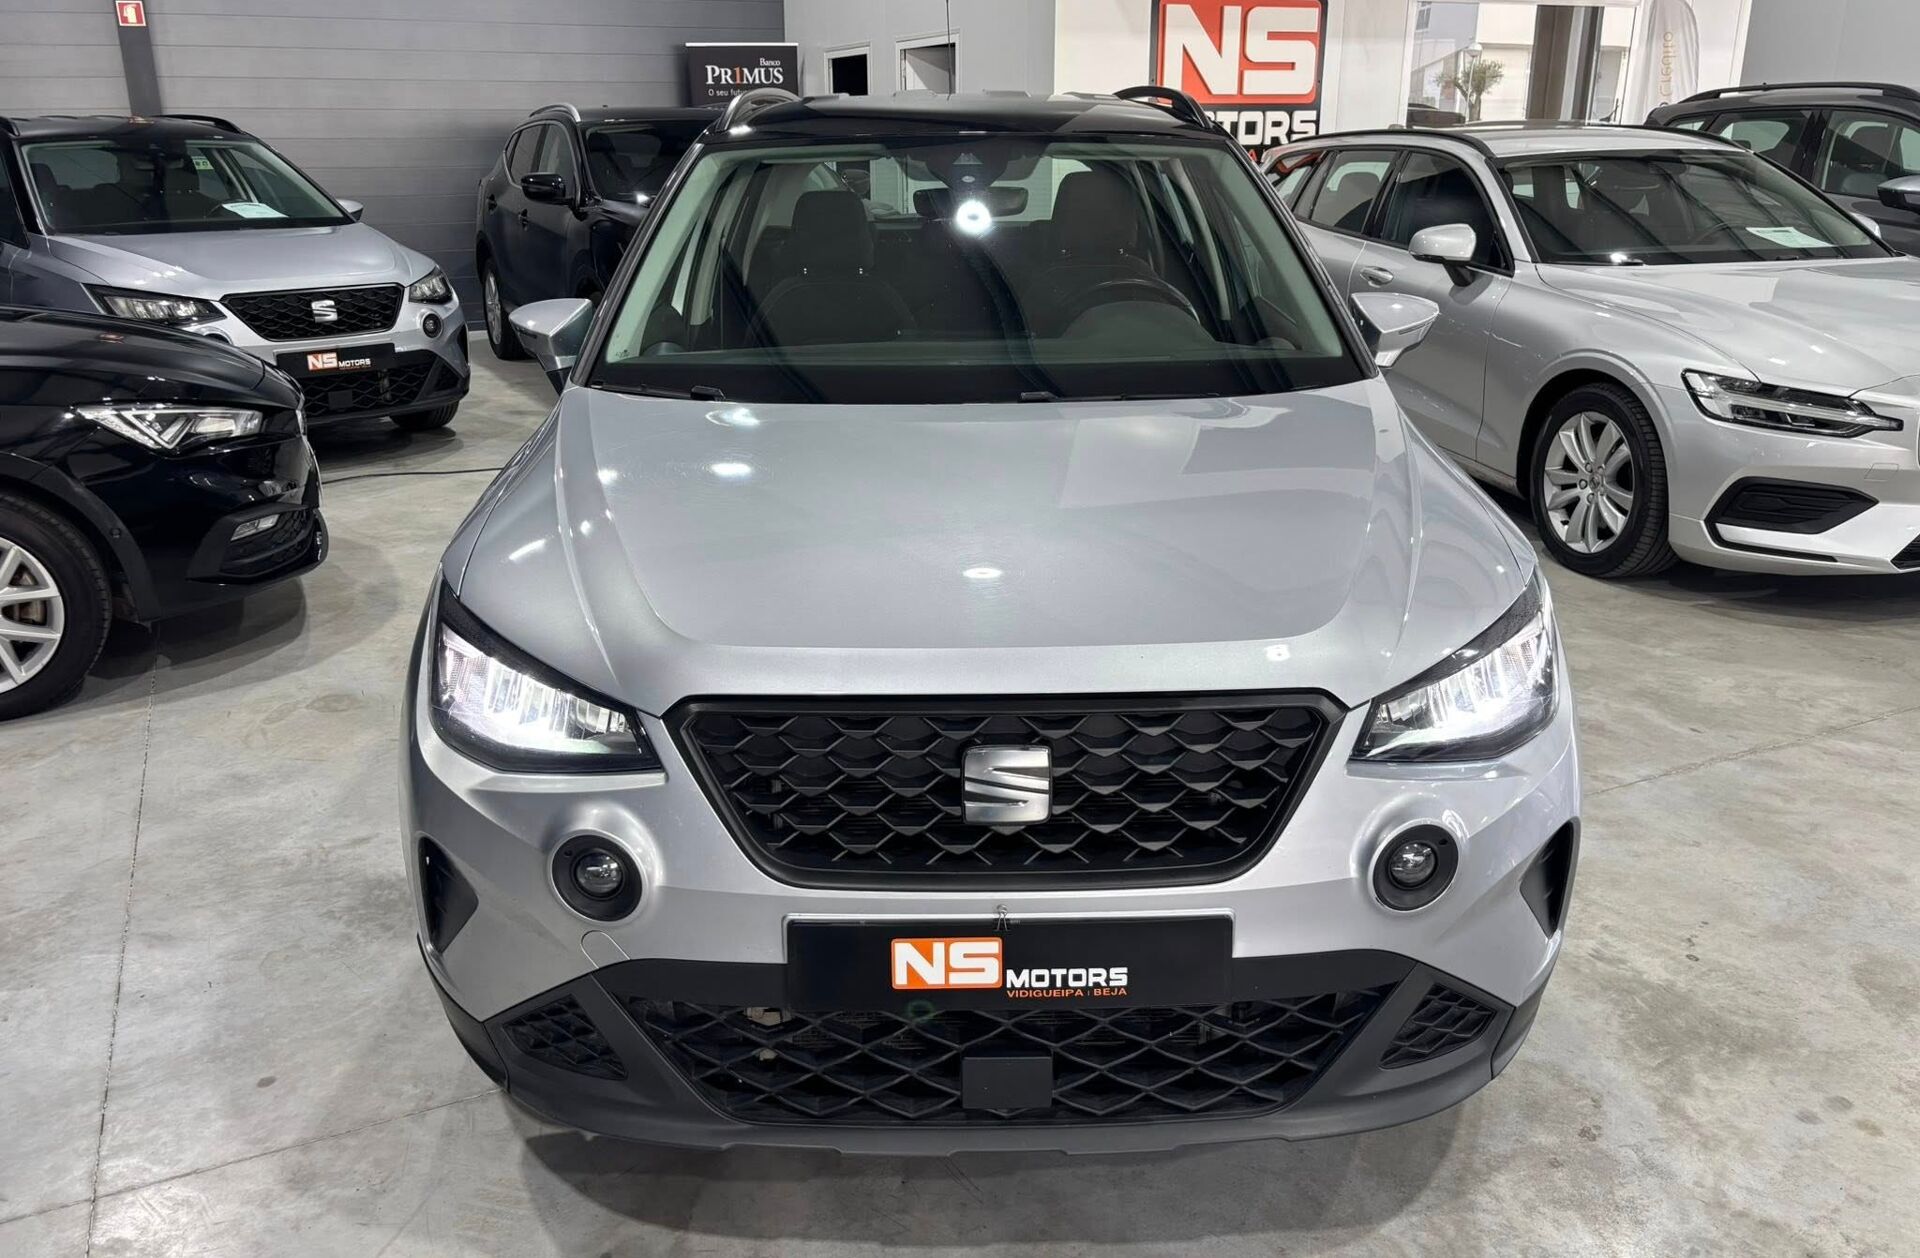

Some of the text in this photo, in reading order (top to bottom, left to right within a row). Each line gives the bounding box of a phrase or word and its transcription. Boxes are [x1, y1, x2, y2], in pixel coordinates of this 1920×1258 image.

[1162, 4, 1319, 95] NS
[759, 57, 781, 66] Banco
[708, 88, 715, 96] O
[1204, 111, 1317, 145] TORS
[307, 352, 338, 371] NS
[338, 358, 371, 368] MOTORS
[894, 941, 1128, 988] NS MOTORS
[1093, 987, 1127, 997] BEJA
